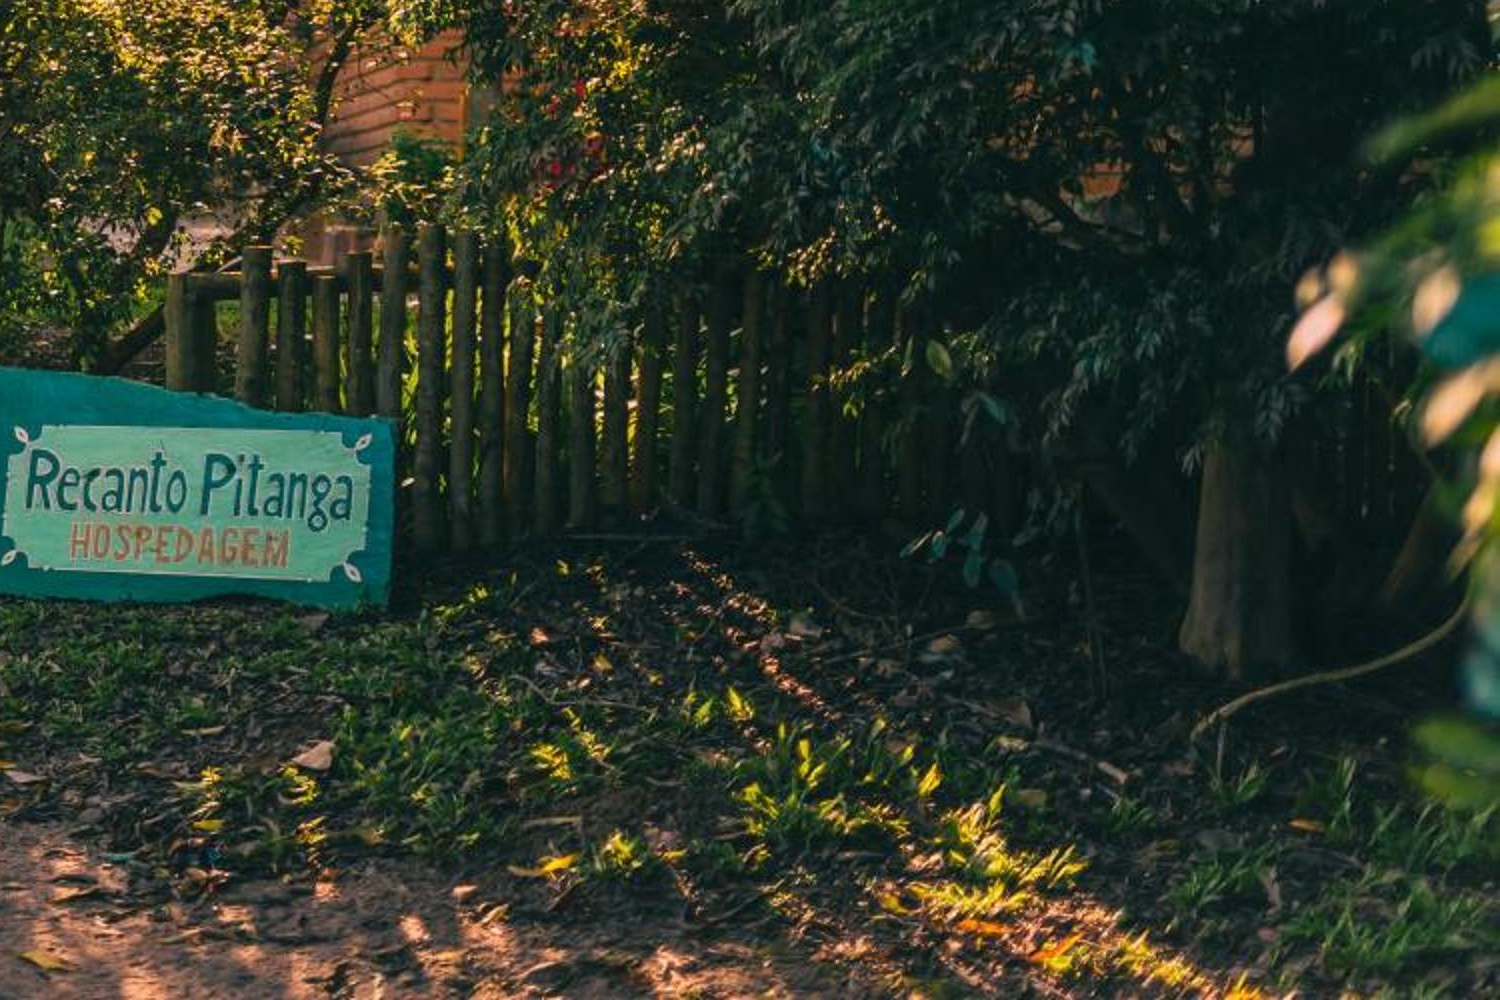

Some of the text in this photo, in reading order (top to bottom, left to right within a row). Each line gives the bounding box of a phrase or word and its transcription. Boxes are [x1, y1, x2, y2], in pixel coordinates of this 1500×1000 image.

[25, 448, 353, 532] Recanto Pitanga
[69, 522, 291, 568] HOSPEDAGEM
